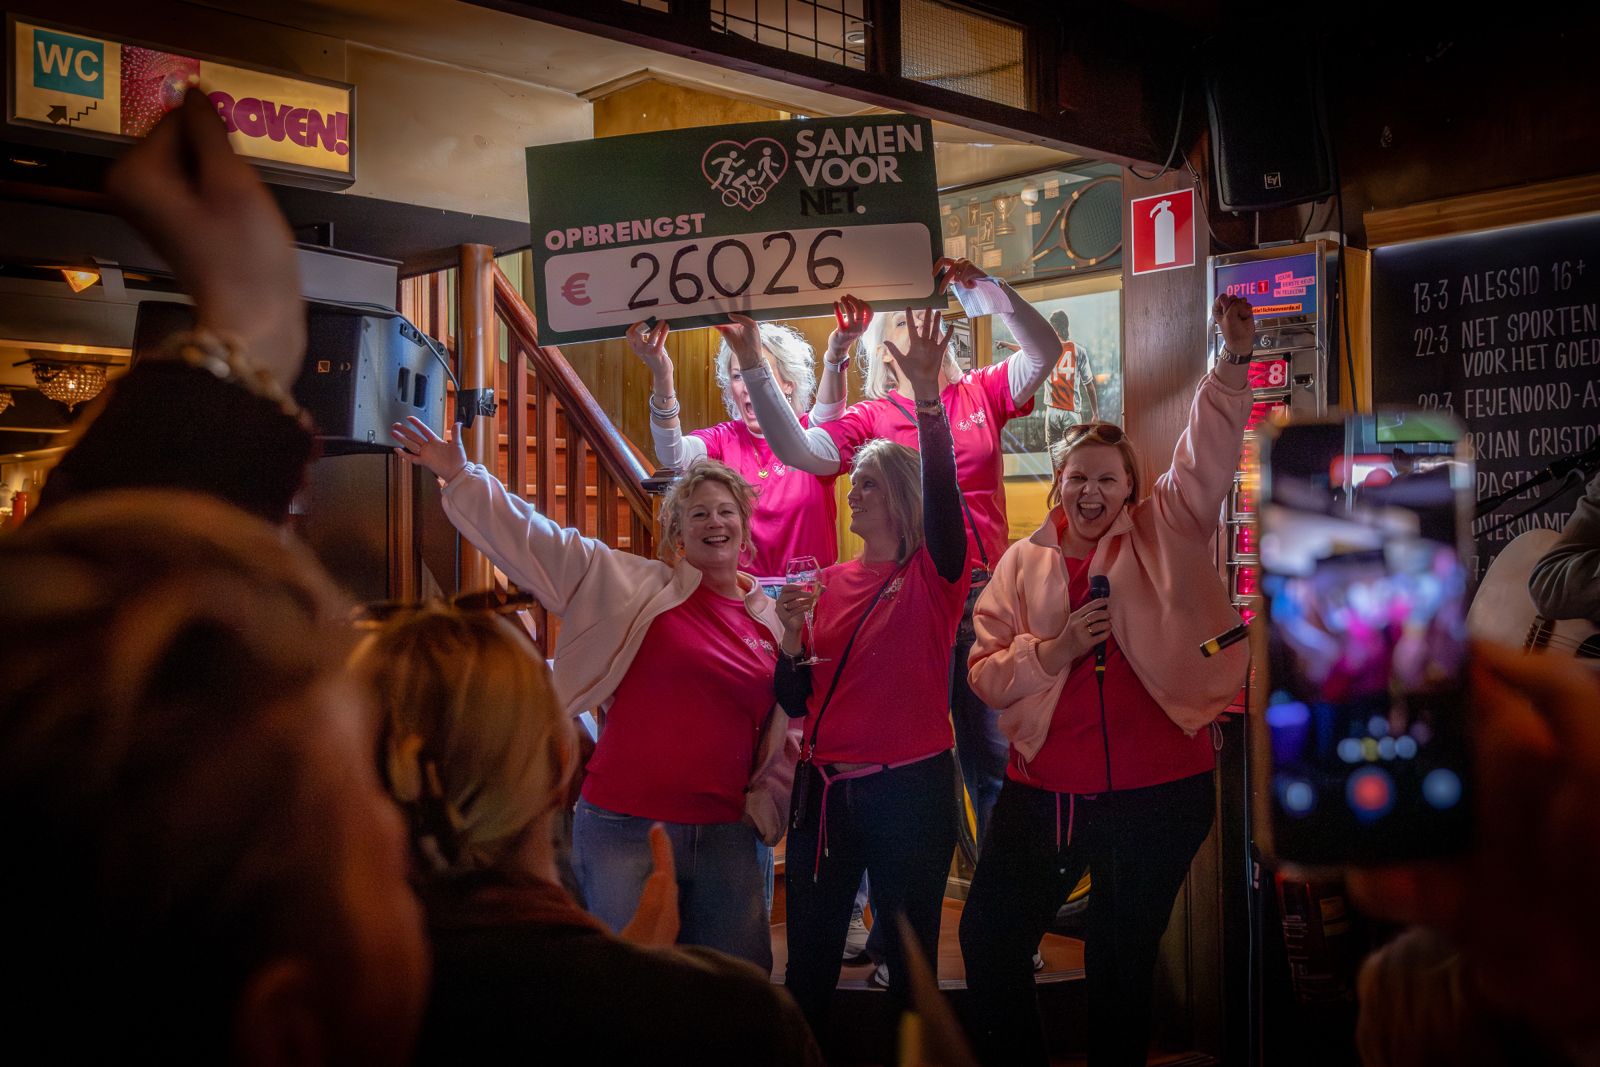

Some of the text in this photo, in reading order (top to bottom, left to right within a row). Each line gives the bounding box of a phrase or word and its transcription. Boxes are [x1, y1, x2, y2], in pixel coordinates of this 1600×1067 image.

[37, 41, 99, 82] WC
[795, 124, 923, 158] SAMEN
[794, 155, 903, 187] VOOR
[800, 186, 867, 216] NET.
[545, 213, 706, 251] OPBRENGST
[561, 229, 845, 311] € 26.026
[1226, 282, 1256, 297] OPTIE
[1461, 316, 1499, 349] NET
[1507, 303, 1598, 343] SPORTEN
[1268, 363, 1283, 385] 8
[1462, 338, 1600, 378] VOOR HET GOED
[1464, 379, 1600, 419] FEIJENOORD-A
[1465, 424, 1600, 461] BRIAN CRISTO
